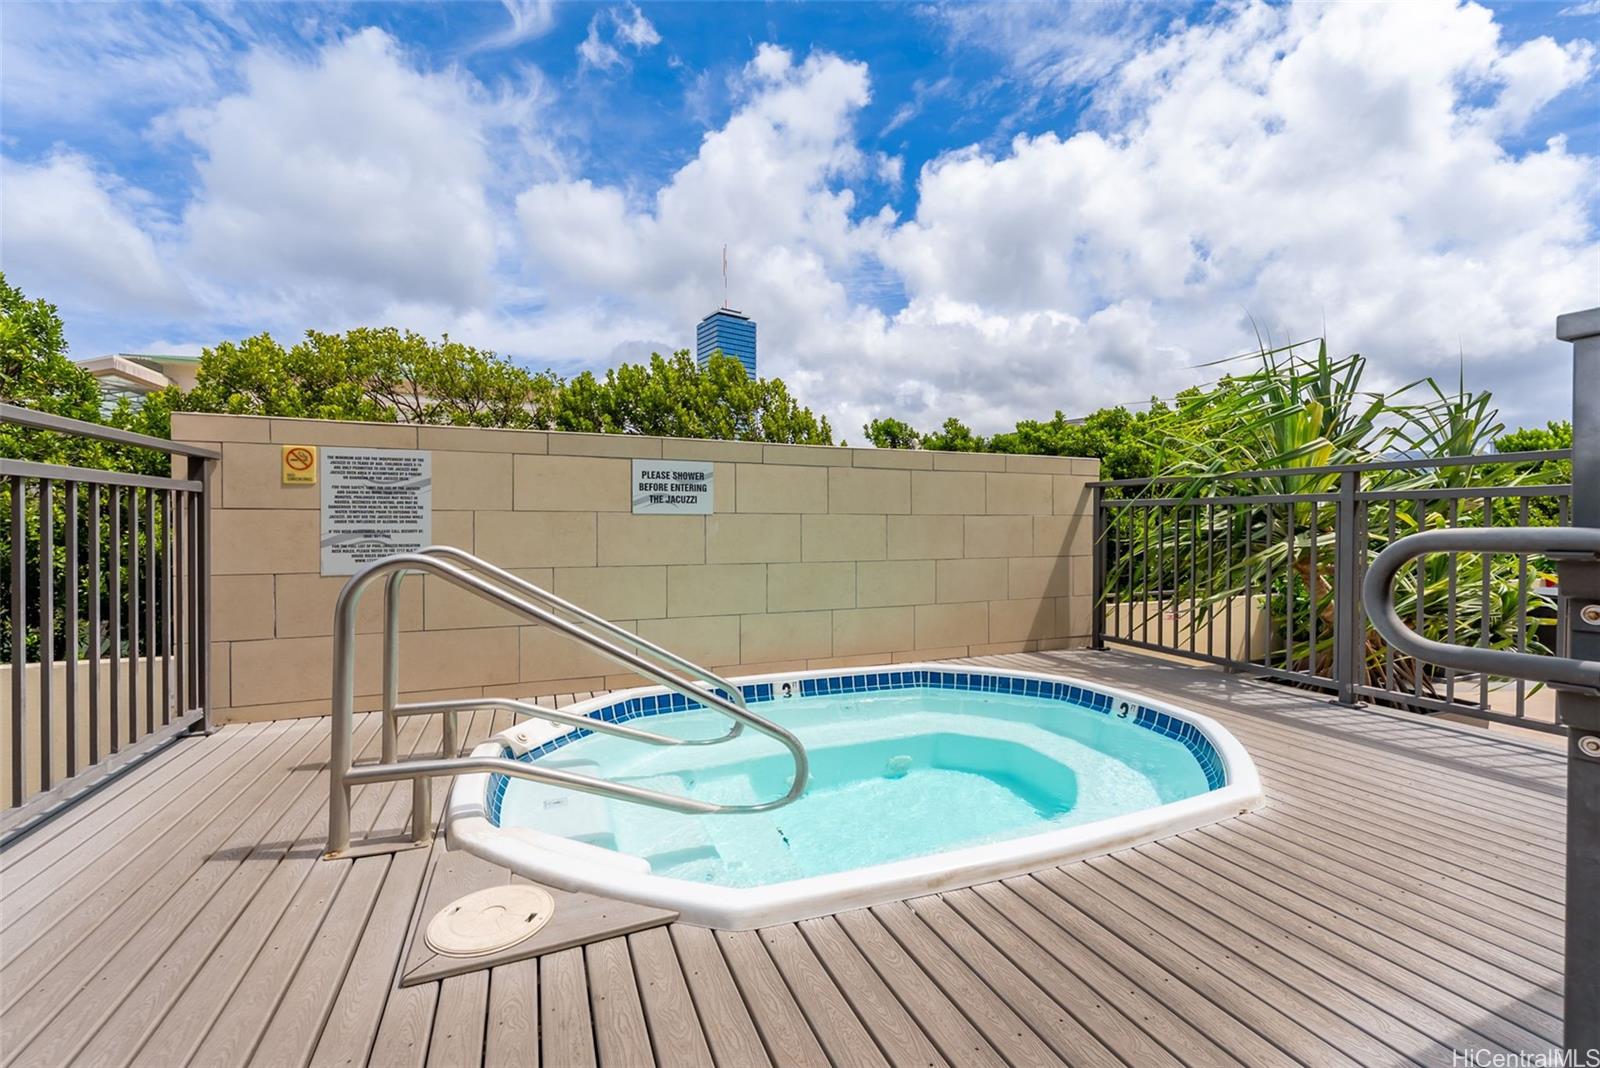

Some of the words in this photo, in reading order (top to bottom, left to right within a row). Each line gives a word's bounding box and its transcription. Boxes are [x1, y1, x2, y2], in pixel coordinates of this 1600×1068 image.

[642, 470, 670, 480] PLEASE
[672, 472, 704, 480] SHOWER
[639, 482, 668, 492] BEFORE
[671, 483, 707, 492] ENTERING
[649, 495, 664, 504] THE
[665, 495, 697, 504] JACUZZI
[782, 682, 792, 698] 3
[1117, 702, 1129, 718] 3
